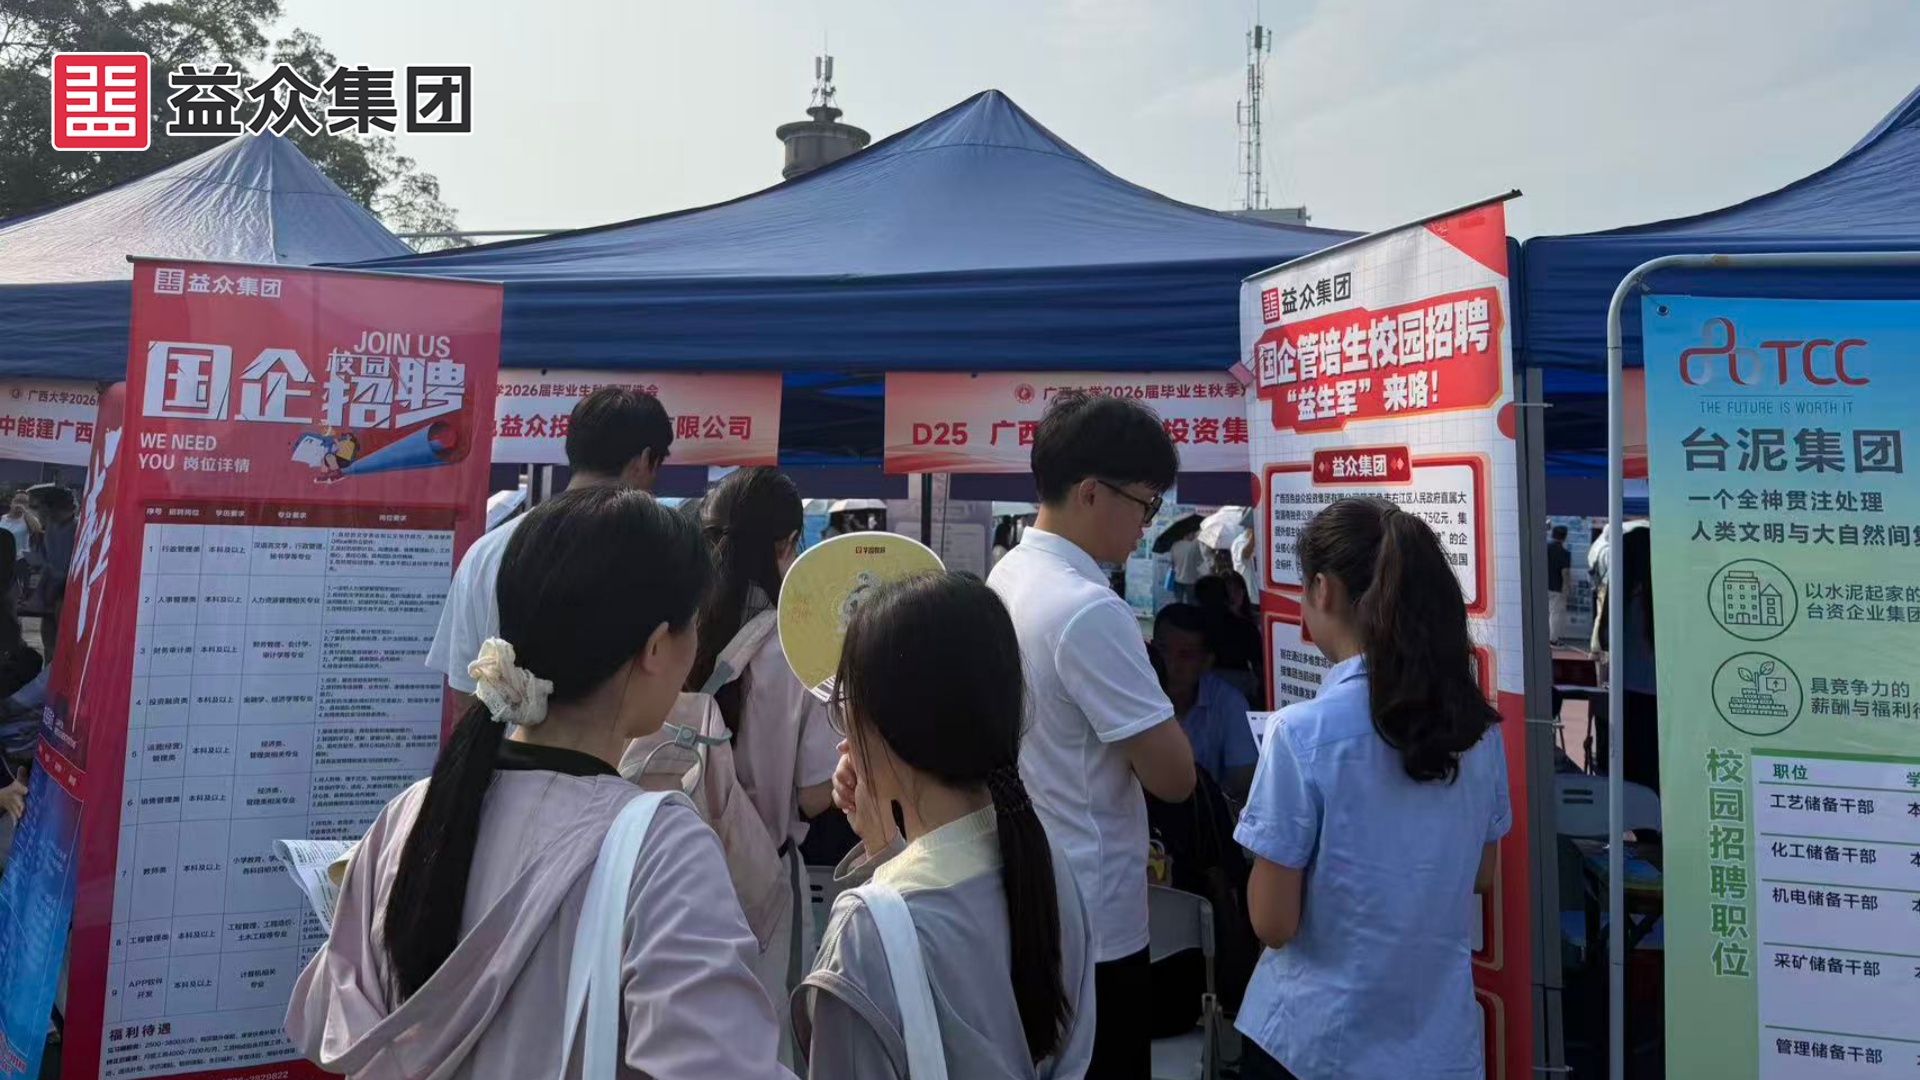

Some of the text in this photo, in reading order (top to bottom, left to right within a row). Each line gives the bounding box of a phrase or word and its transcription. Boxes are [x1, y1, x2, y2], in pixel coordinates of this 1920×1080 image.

[188, 274, 282, 298] 益众集团
[1281, 271, 1351, 315] 益众集团
[353, 331, 452, 357] JOIN US
[1258, 297, 1490, 388] 国企管培生校园招聘
[326, 348, 391, 378] 校园
[1759, 338, 1871, 386] TCC
[28, 389, 99, 406] 广西大学2026
[1700, 401, 1854, 415] THE FUTURE IS WORTH IT
[140, 433, 218, 452] WE NEED
[912, 423, 969, 446] D25
[1681, 426, 1904, 474] 台泥集团
[138, 452, 250, 473] YOU 岗位详情
[1332, 454, 1387, 478] 益众集团
[1688, 489, 1884, 512] 一个全神贯注处理
[1807, 604, 1920, 623] 台资企业集团
[1810, 678, 1910, 698] 具竞争力的
[1772, 764, 1808, 781] 职位
[1770, 794, 1875, 816] 工艺储备干部
[1706, 748, 1750, 978] 校园招聘职位
[1771, 841, 1877, 865] 化工储备干部
[1772, 887, 1879, 911] 机电储备干部
[1774, 953, 1881, 978] 采矿储备干部
[108, 1023, 171, 1042] 福利待遇
[1775, 1038, 1883, 1065] 管理储备干部
